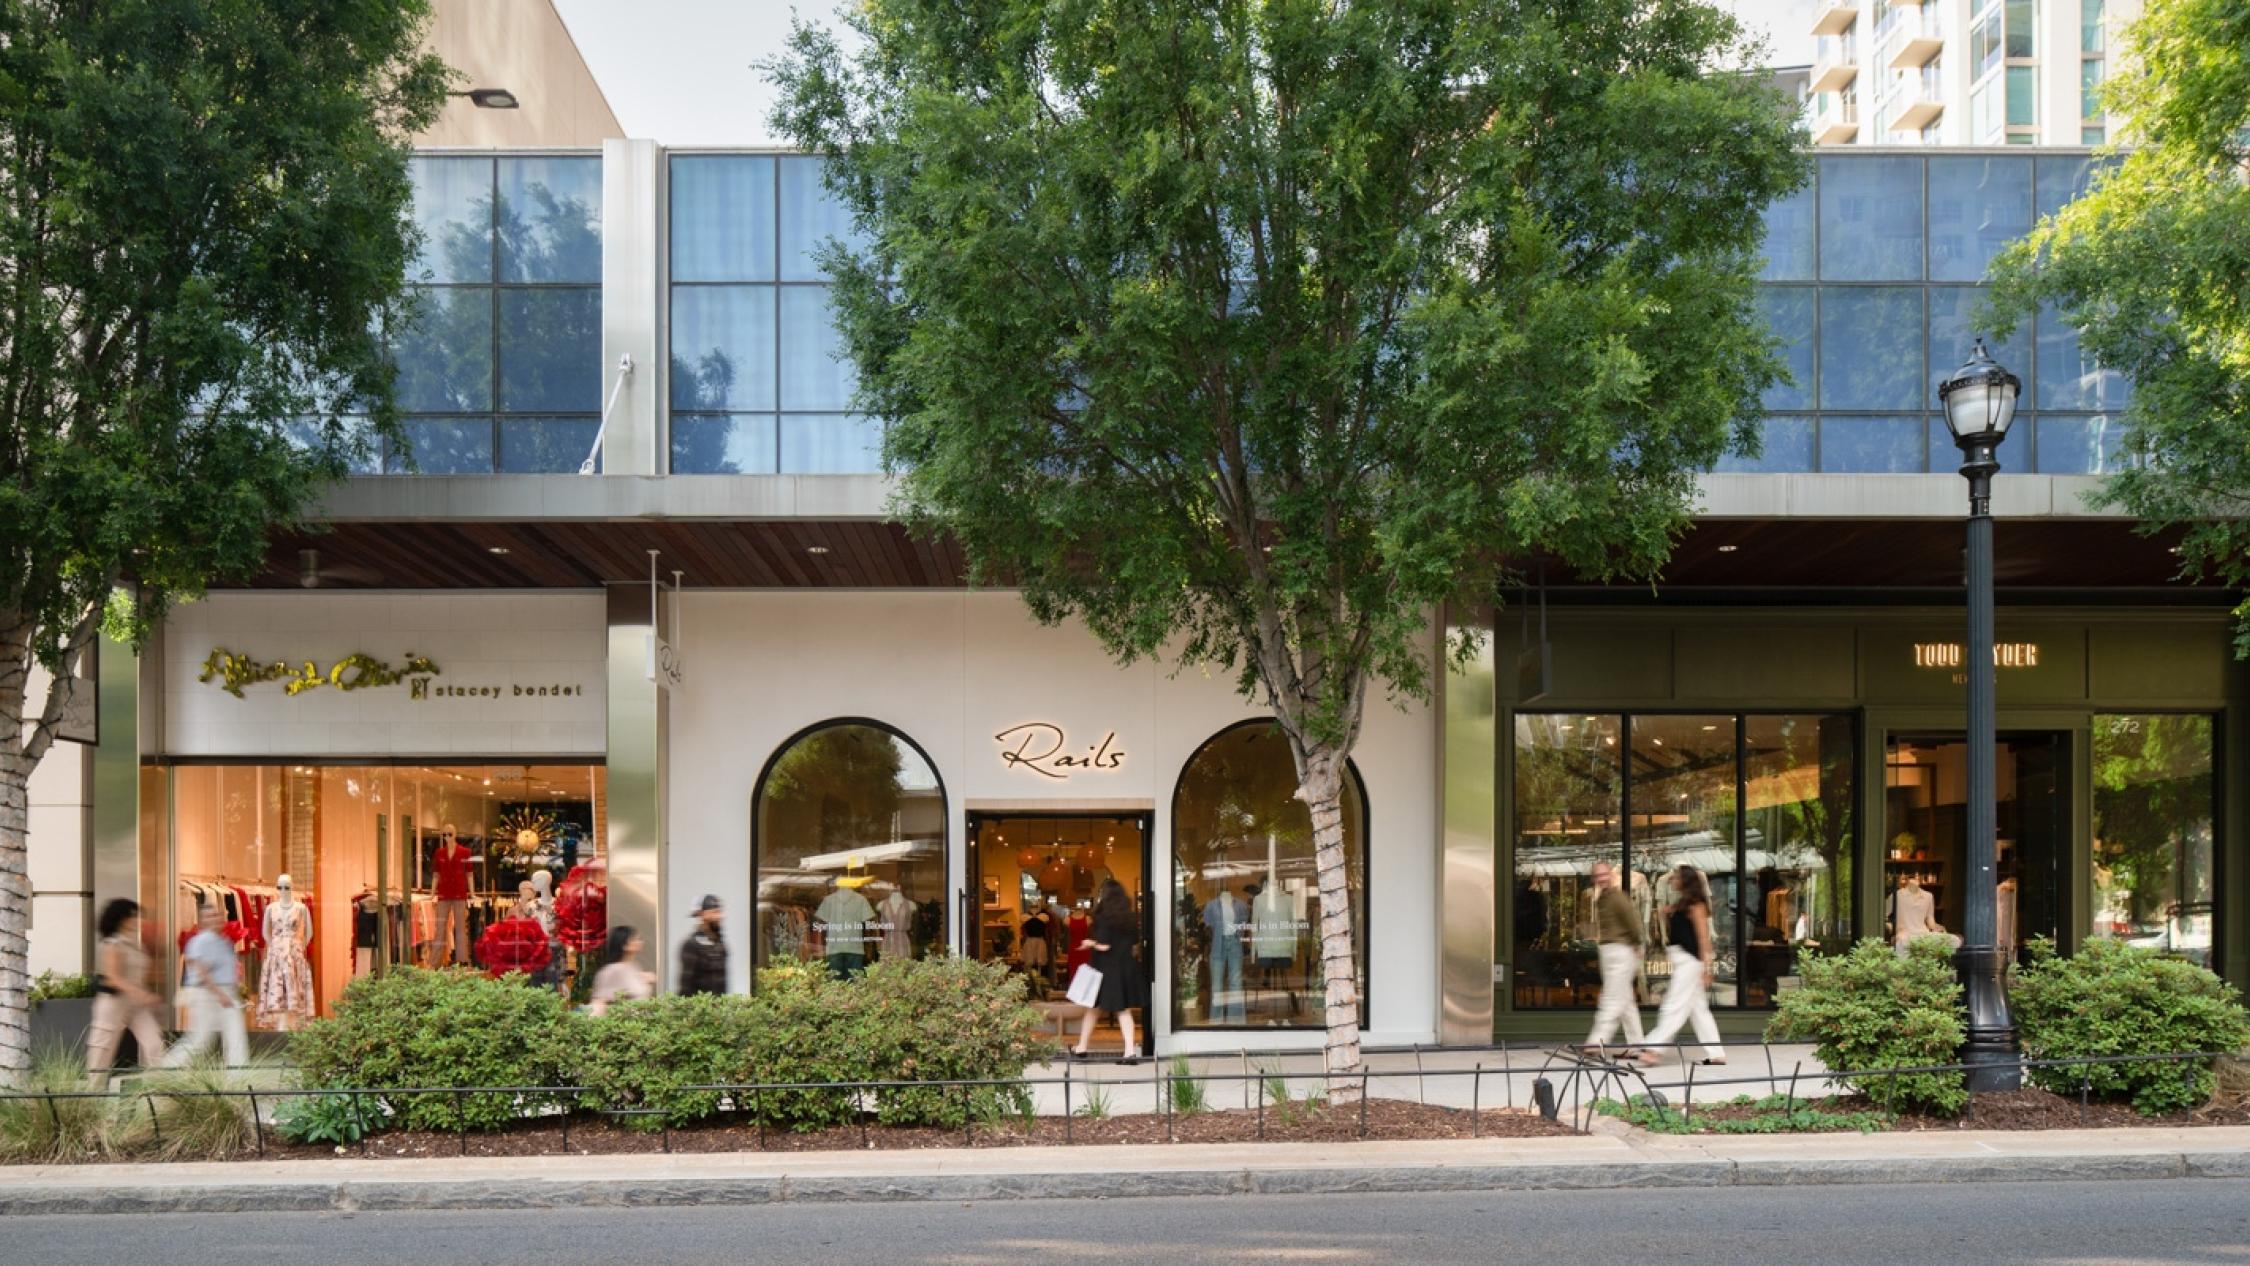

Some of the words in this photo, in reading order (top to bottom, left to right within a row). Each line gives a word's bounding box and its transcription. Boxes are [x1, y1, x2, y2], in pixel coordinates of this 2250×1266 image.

[1914, 643, 1959, 667] TODD
[1966, 643, 2038, 667] YDER
[1952, 674, 1968, 684] NE
[436, 685, 501, 698] stacey
[513, 684, 582, 697] bendet
[2110, 720, 2139, 734] 272
[994, 722, 1125, 778] Rails
[813, 921, 843, 932] Spring
[844, 921, 852, 930] is
[854, 921, 863, 930] in
[865, 920, 895, 930] Bloom
[1227, 921, 1257, 932] Spring
[1259, 921, 1267, 930] is
[1268, 921, 1278, 930] in
[1279, 920, 1310, 930] Bloom
